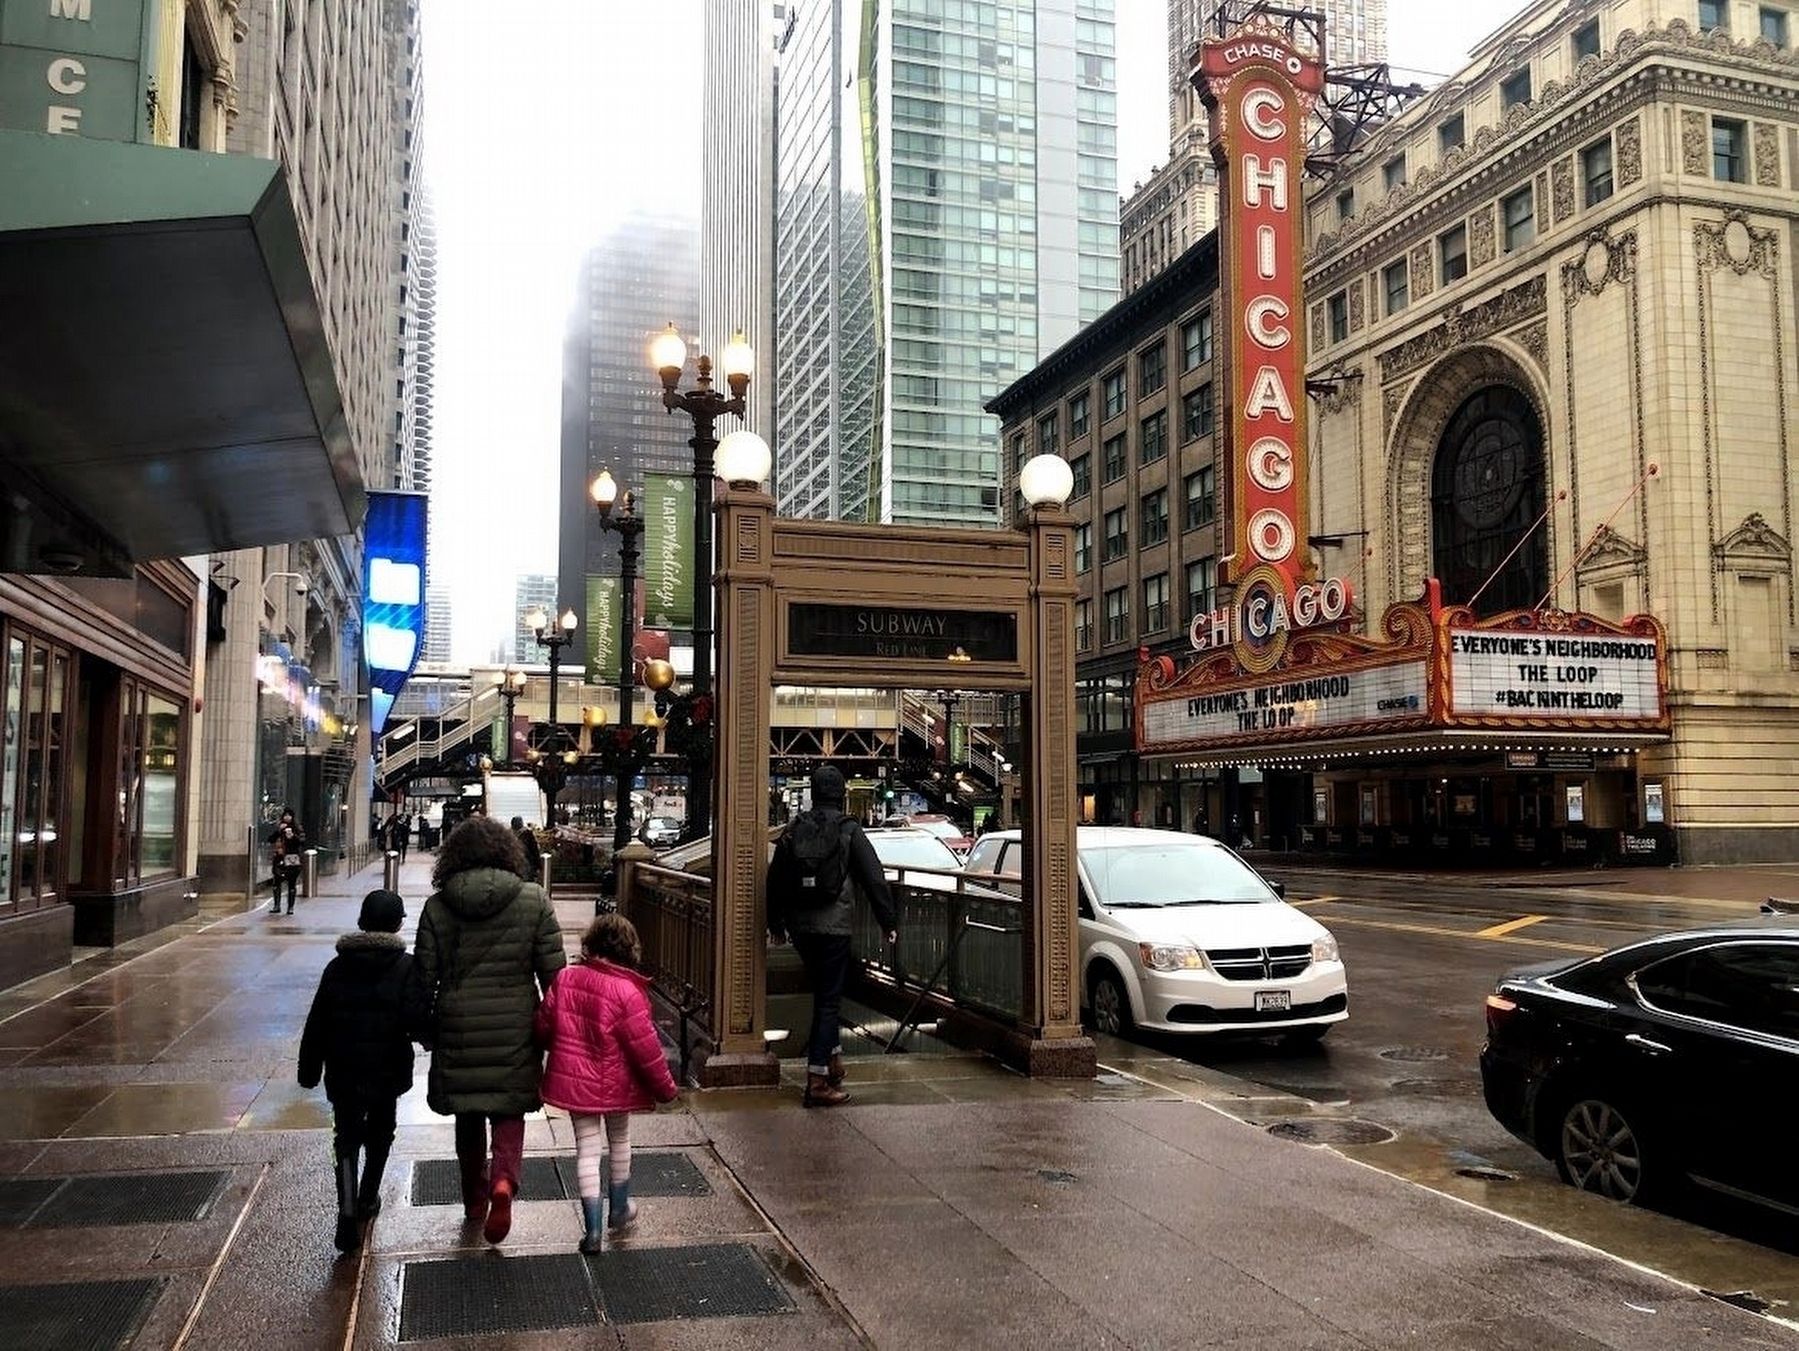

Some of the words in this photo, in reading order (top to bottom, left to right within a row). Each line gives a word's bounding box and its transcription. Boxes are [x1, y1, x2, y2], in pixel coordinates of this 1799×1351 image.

[1223, 43, 1285, 64] CHASE
[1240, 87, 1295, 564] CHICAGO
[857, 611, 947, 636] SUBWAY
[1189, 576, 1346, 650] CHICAGO
[1452, 634, 1542, 656] EVERYONE'S
[1545, 639, 1656, 661] NEIGHBORHOOD
[1517, 664, 1549, 682] THE
[1556, 665, 1599, 684] LOOP
[1187, 690, 1249, 717] EVERYONE'S
[1254, 676, 1350, 708] NEIGHBORHOOD
[1236, 709, 1259, 732] THE
